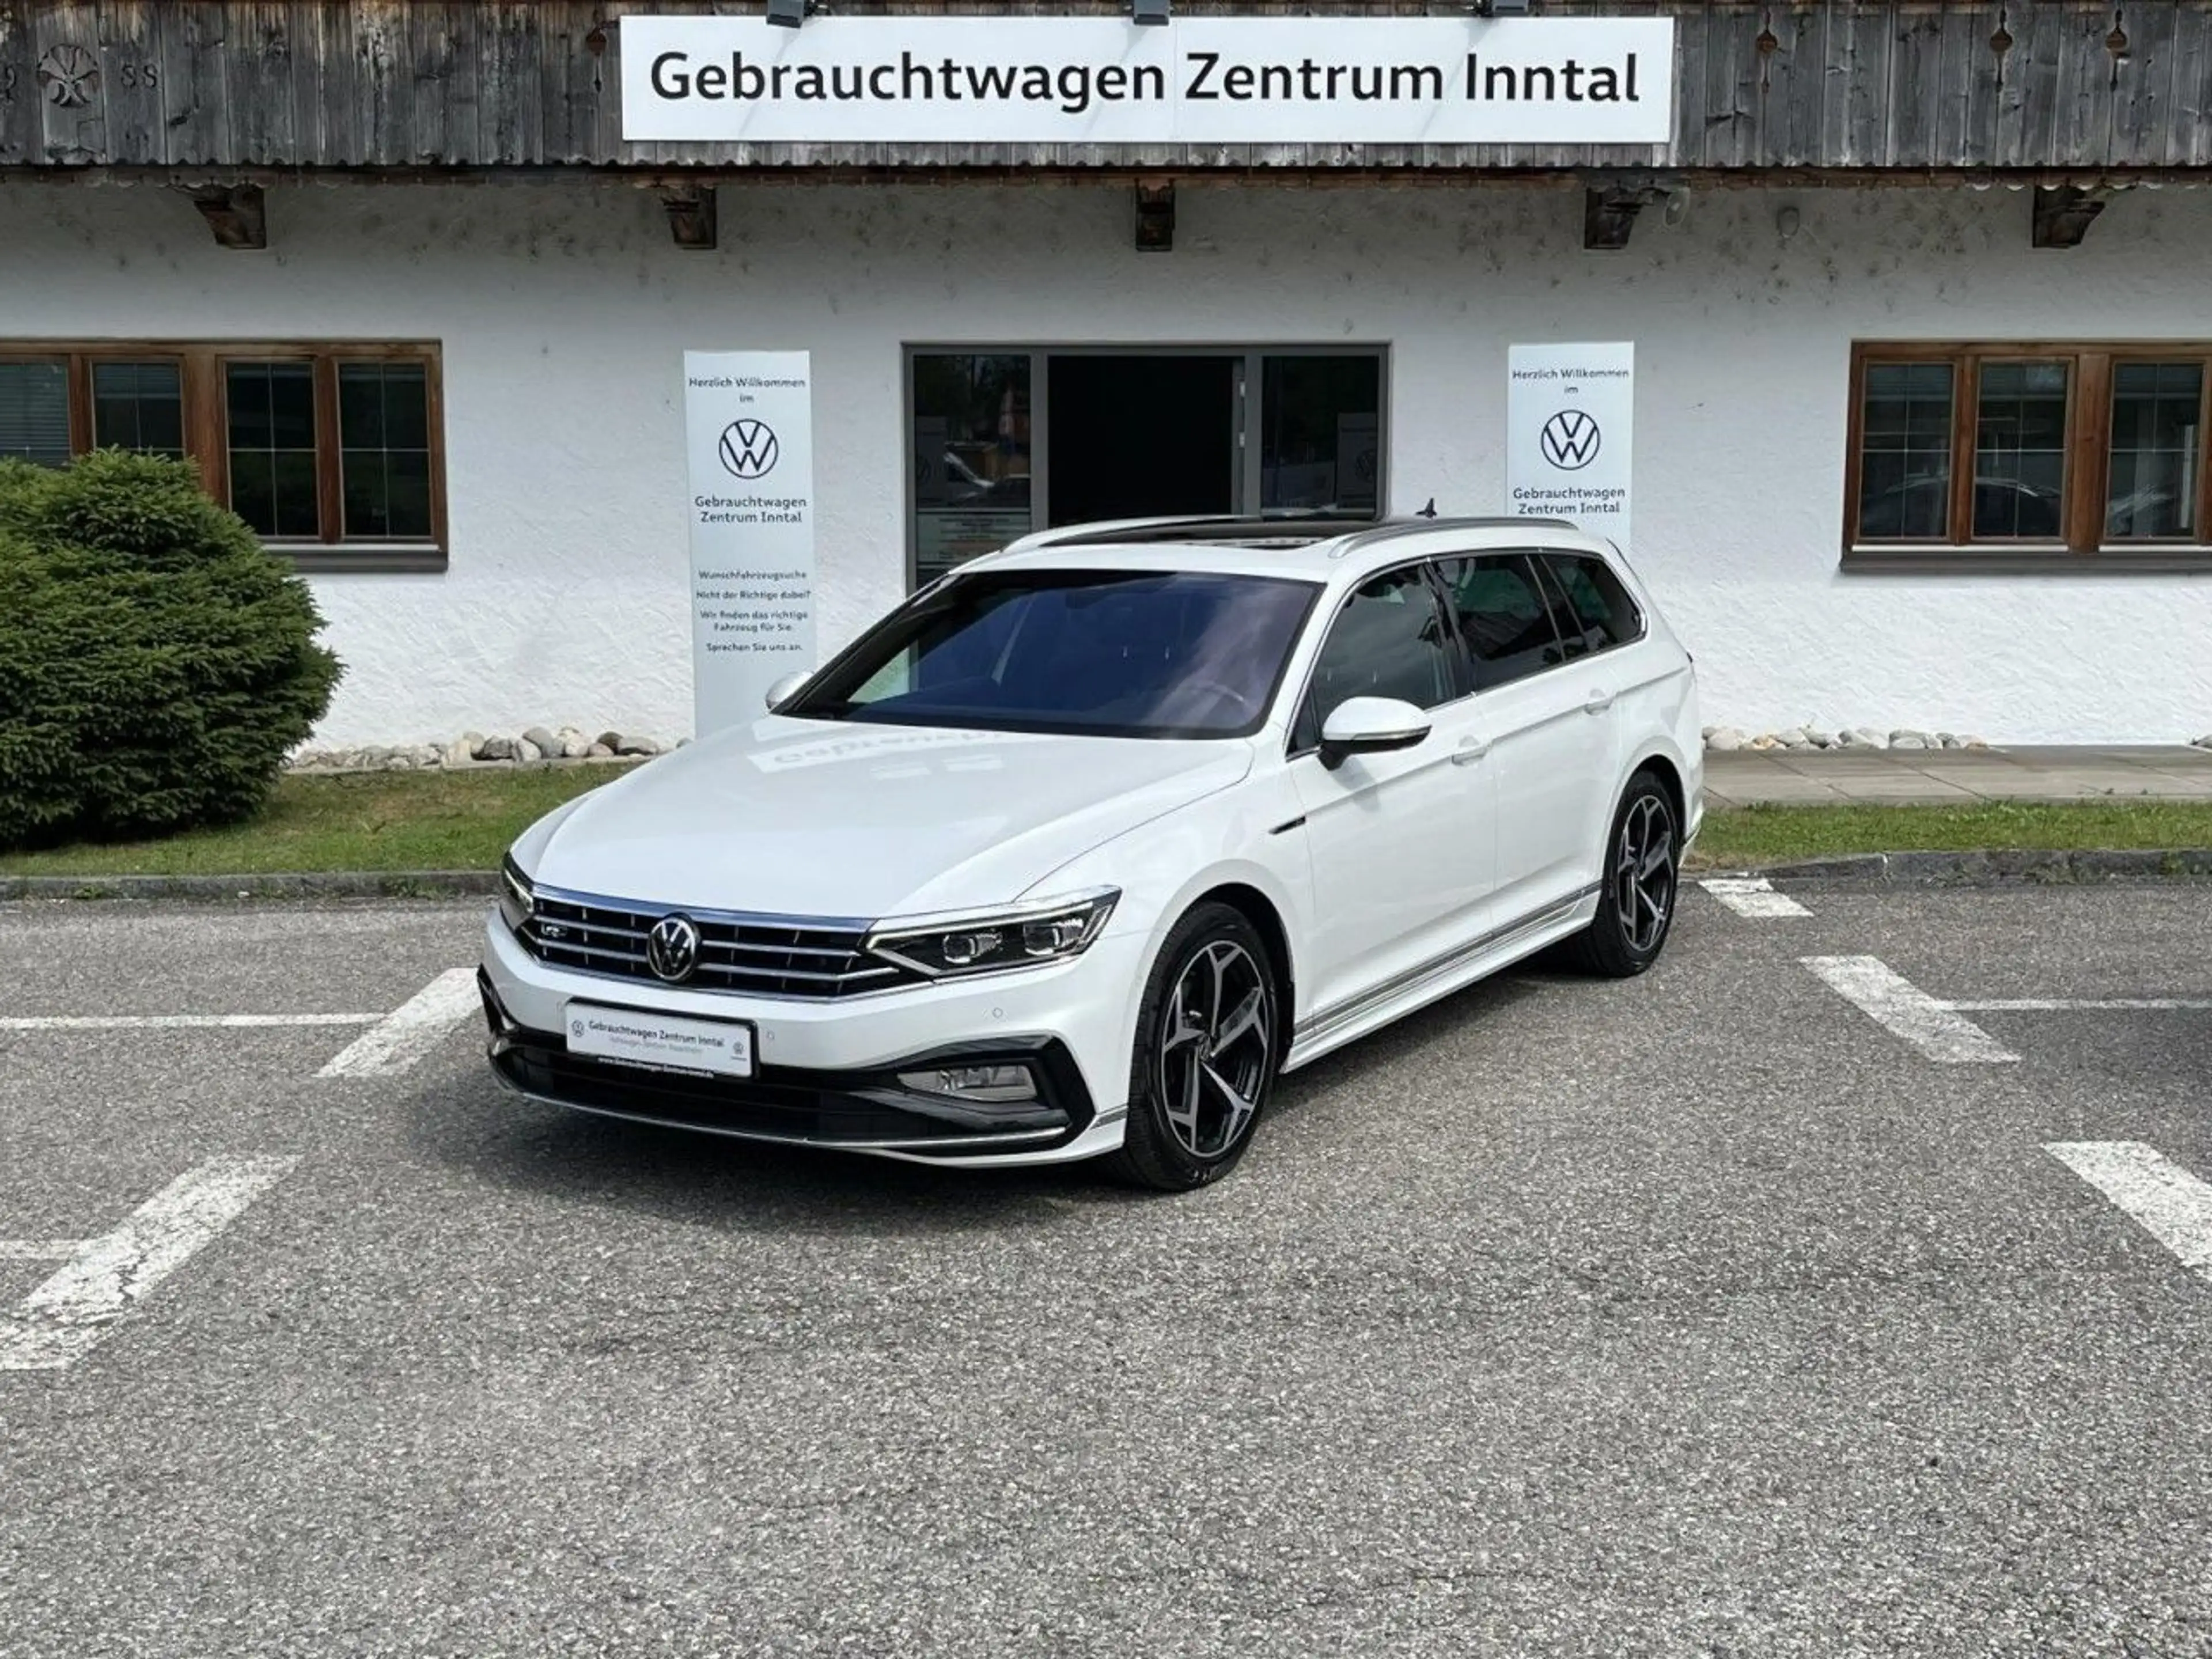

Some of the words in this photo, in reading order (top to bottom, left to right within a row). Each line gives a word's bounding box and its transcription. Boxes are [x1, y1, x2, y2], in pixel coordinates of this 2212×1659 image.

[651, 51, 1164, 114] Gebrauchtwagen
[1185, 52, 1442, 101] Zentrum
[1466, 52, 1640, 102] Inntal
[1512, 369, 1558, 380] Herzlich
[1560, 368, 1629, 379] Willkommen
[688, 377, 733, 388] Herzlich
[735, 377, 805, 388] Willkommen
[1564, 385, 1580, 394] im
[739, 394, 755, 403] im
[1540, 409, 1601, 471] VW
[718, 418, 779, 480] VW
[1512, 487, 1626, 501] Gebrauchtwagen
[694, 494, 808, 510] Gebrauchtwagen
[1518, 503, 1577, 515] Zentrum
[1580, 502, 1620, 514] Inntal
[700, 511, 758, 523] Zentrum
[760, 511, 802, 523] Inntal
[696, 590, 721, 600] Nicht
[740, 590, 778, 601] Richtige
[699, 610, 717, 620] Wir
[719, 610, 750, 620] finden
[752, 610, 769, 620] das
[770, 610, 808, 622] richtige
[713, 622, 758, 633] Fahrzeug
[706, 642, 751, 653] Sprechen
[752, 642, 767, 652] Sie
[769, 643, 786, 652] uns
